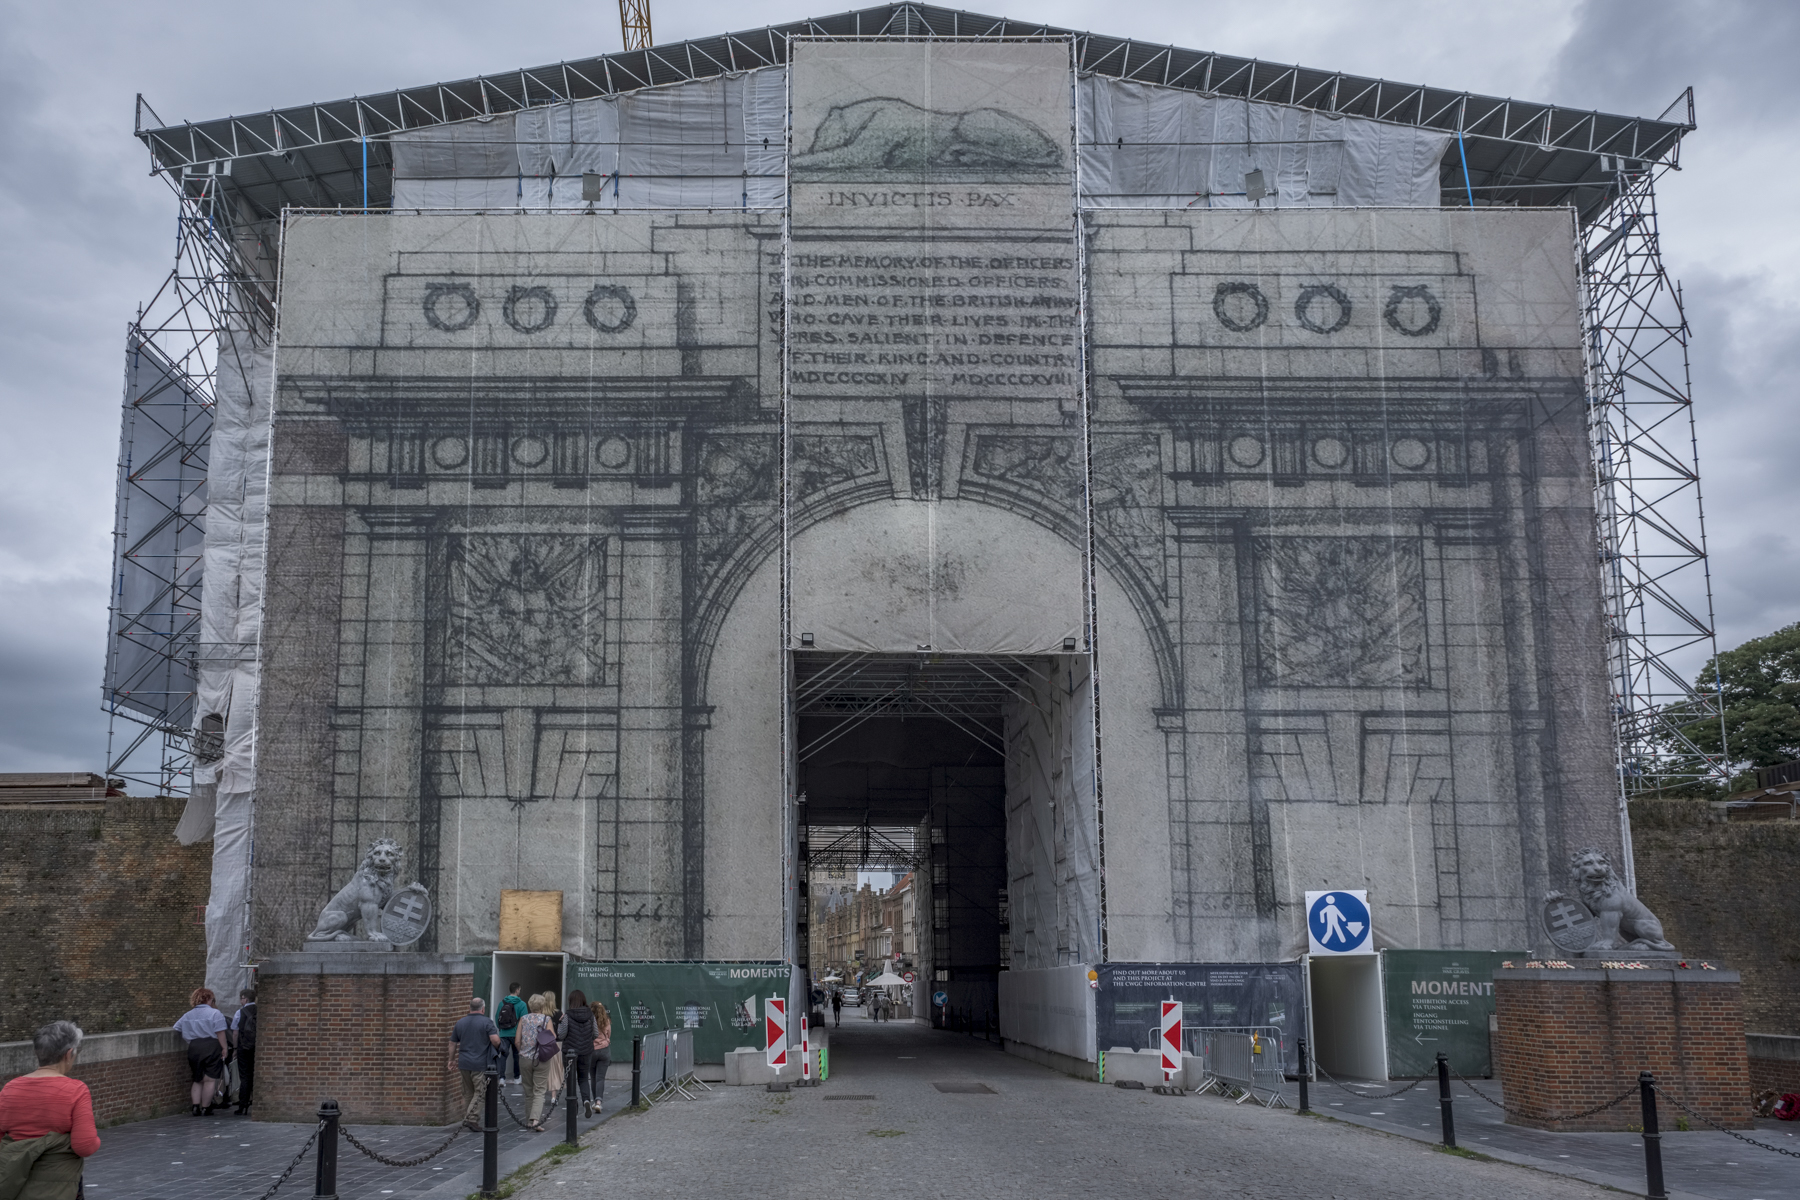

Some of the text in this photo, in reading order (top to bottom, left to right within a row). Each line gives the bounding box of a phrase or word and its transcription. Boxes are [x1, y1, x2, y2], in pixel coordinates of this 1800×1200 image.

[828, 191, 1015, 207] INVICTIS PAX
[730, 968, 790, 979] MOMENTS
